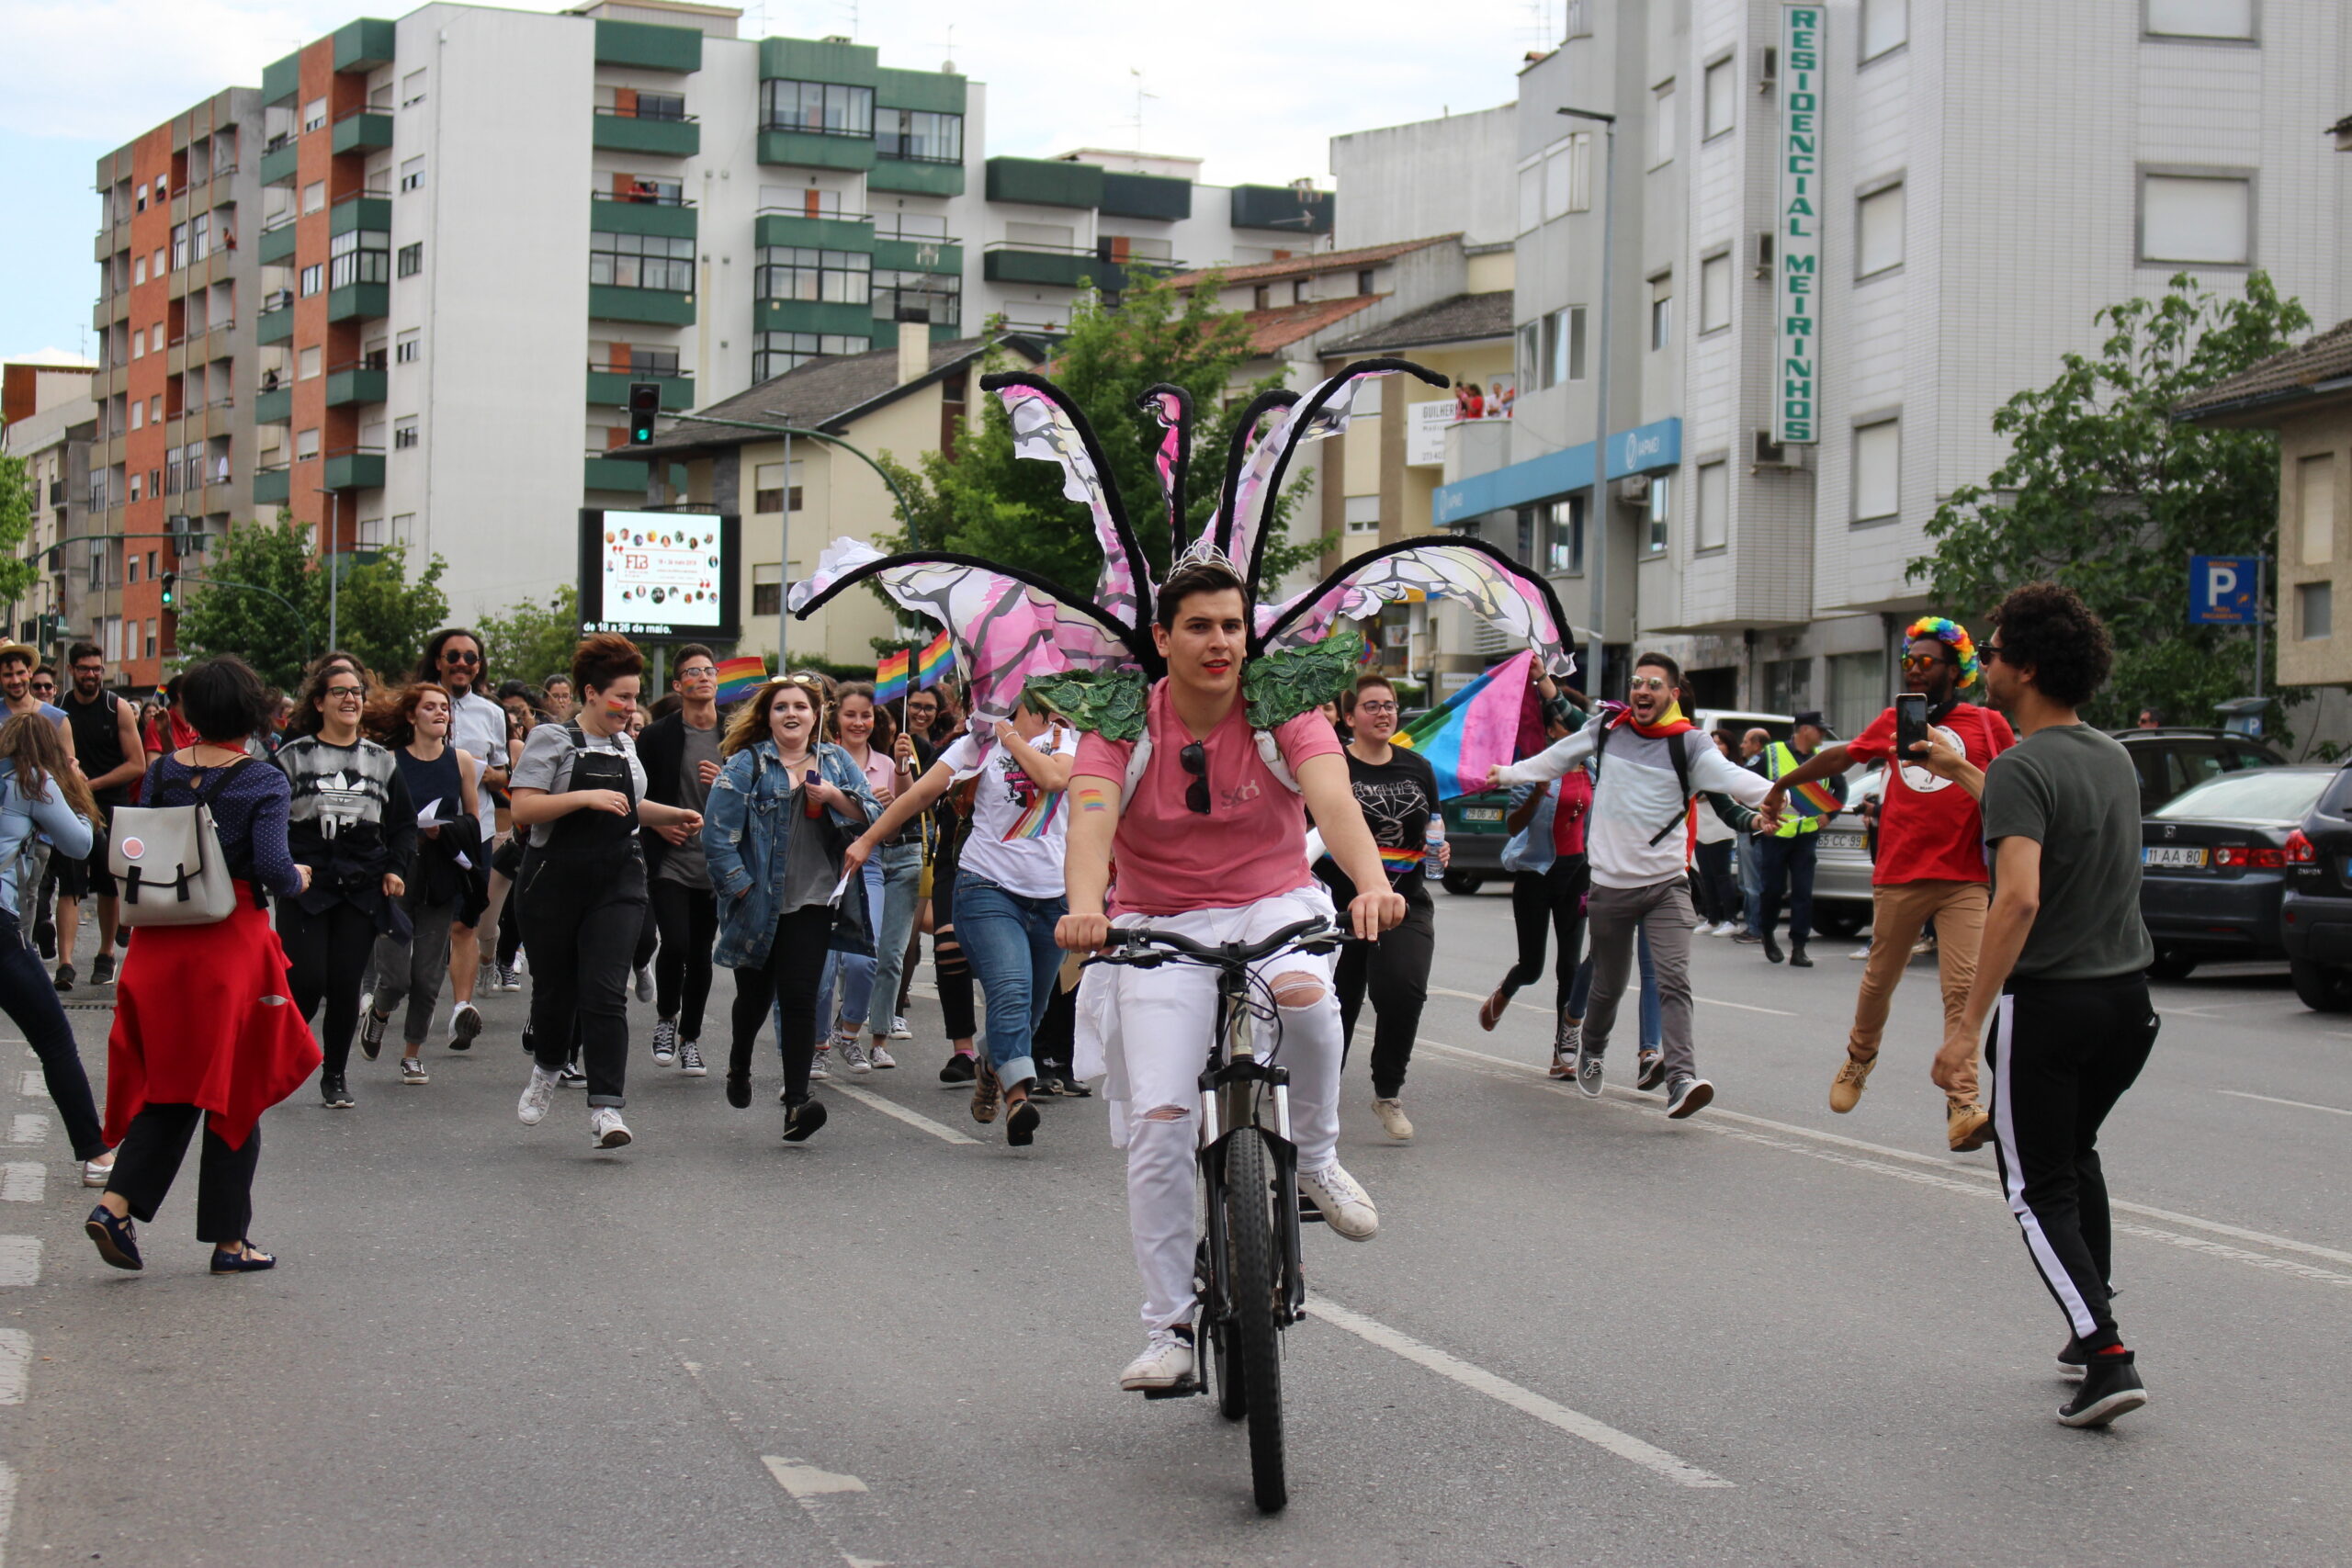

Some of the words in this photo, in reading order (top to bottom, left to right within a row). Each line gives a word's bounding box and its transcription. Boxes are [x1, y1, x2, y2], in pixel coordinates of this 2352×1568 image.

[1787, 9, 1817, 237] RESIDENCIAL
[1784, 254, 1815, 440] MEIRINHOS
[2209, 568, 2237, 606] P
[582, 621, 596, 632] de
[610, 624, 617, 632] a
[631, 624, 645, 633] de
[645, 624, 672, 634] maio.
[2249, 717, 2260, 735] P
[1832, 835, 1848, 846] CC
[1849, 836, 1861, 846] 99
[2148, 850, 2159, 862] 11
[2161, 850, 2180, 862] AA
[2186, 850, 2201, 863] 80
